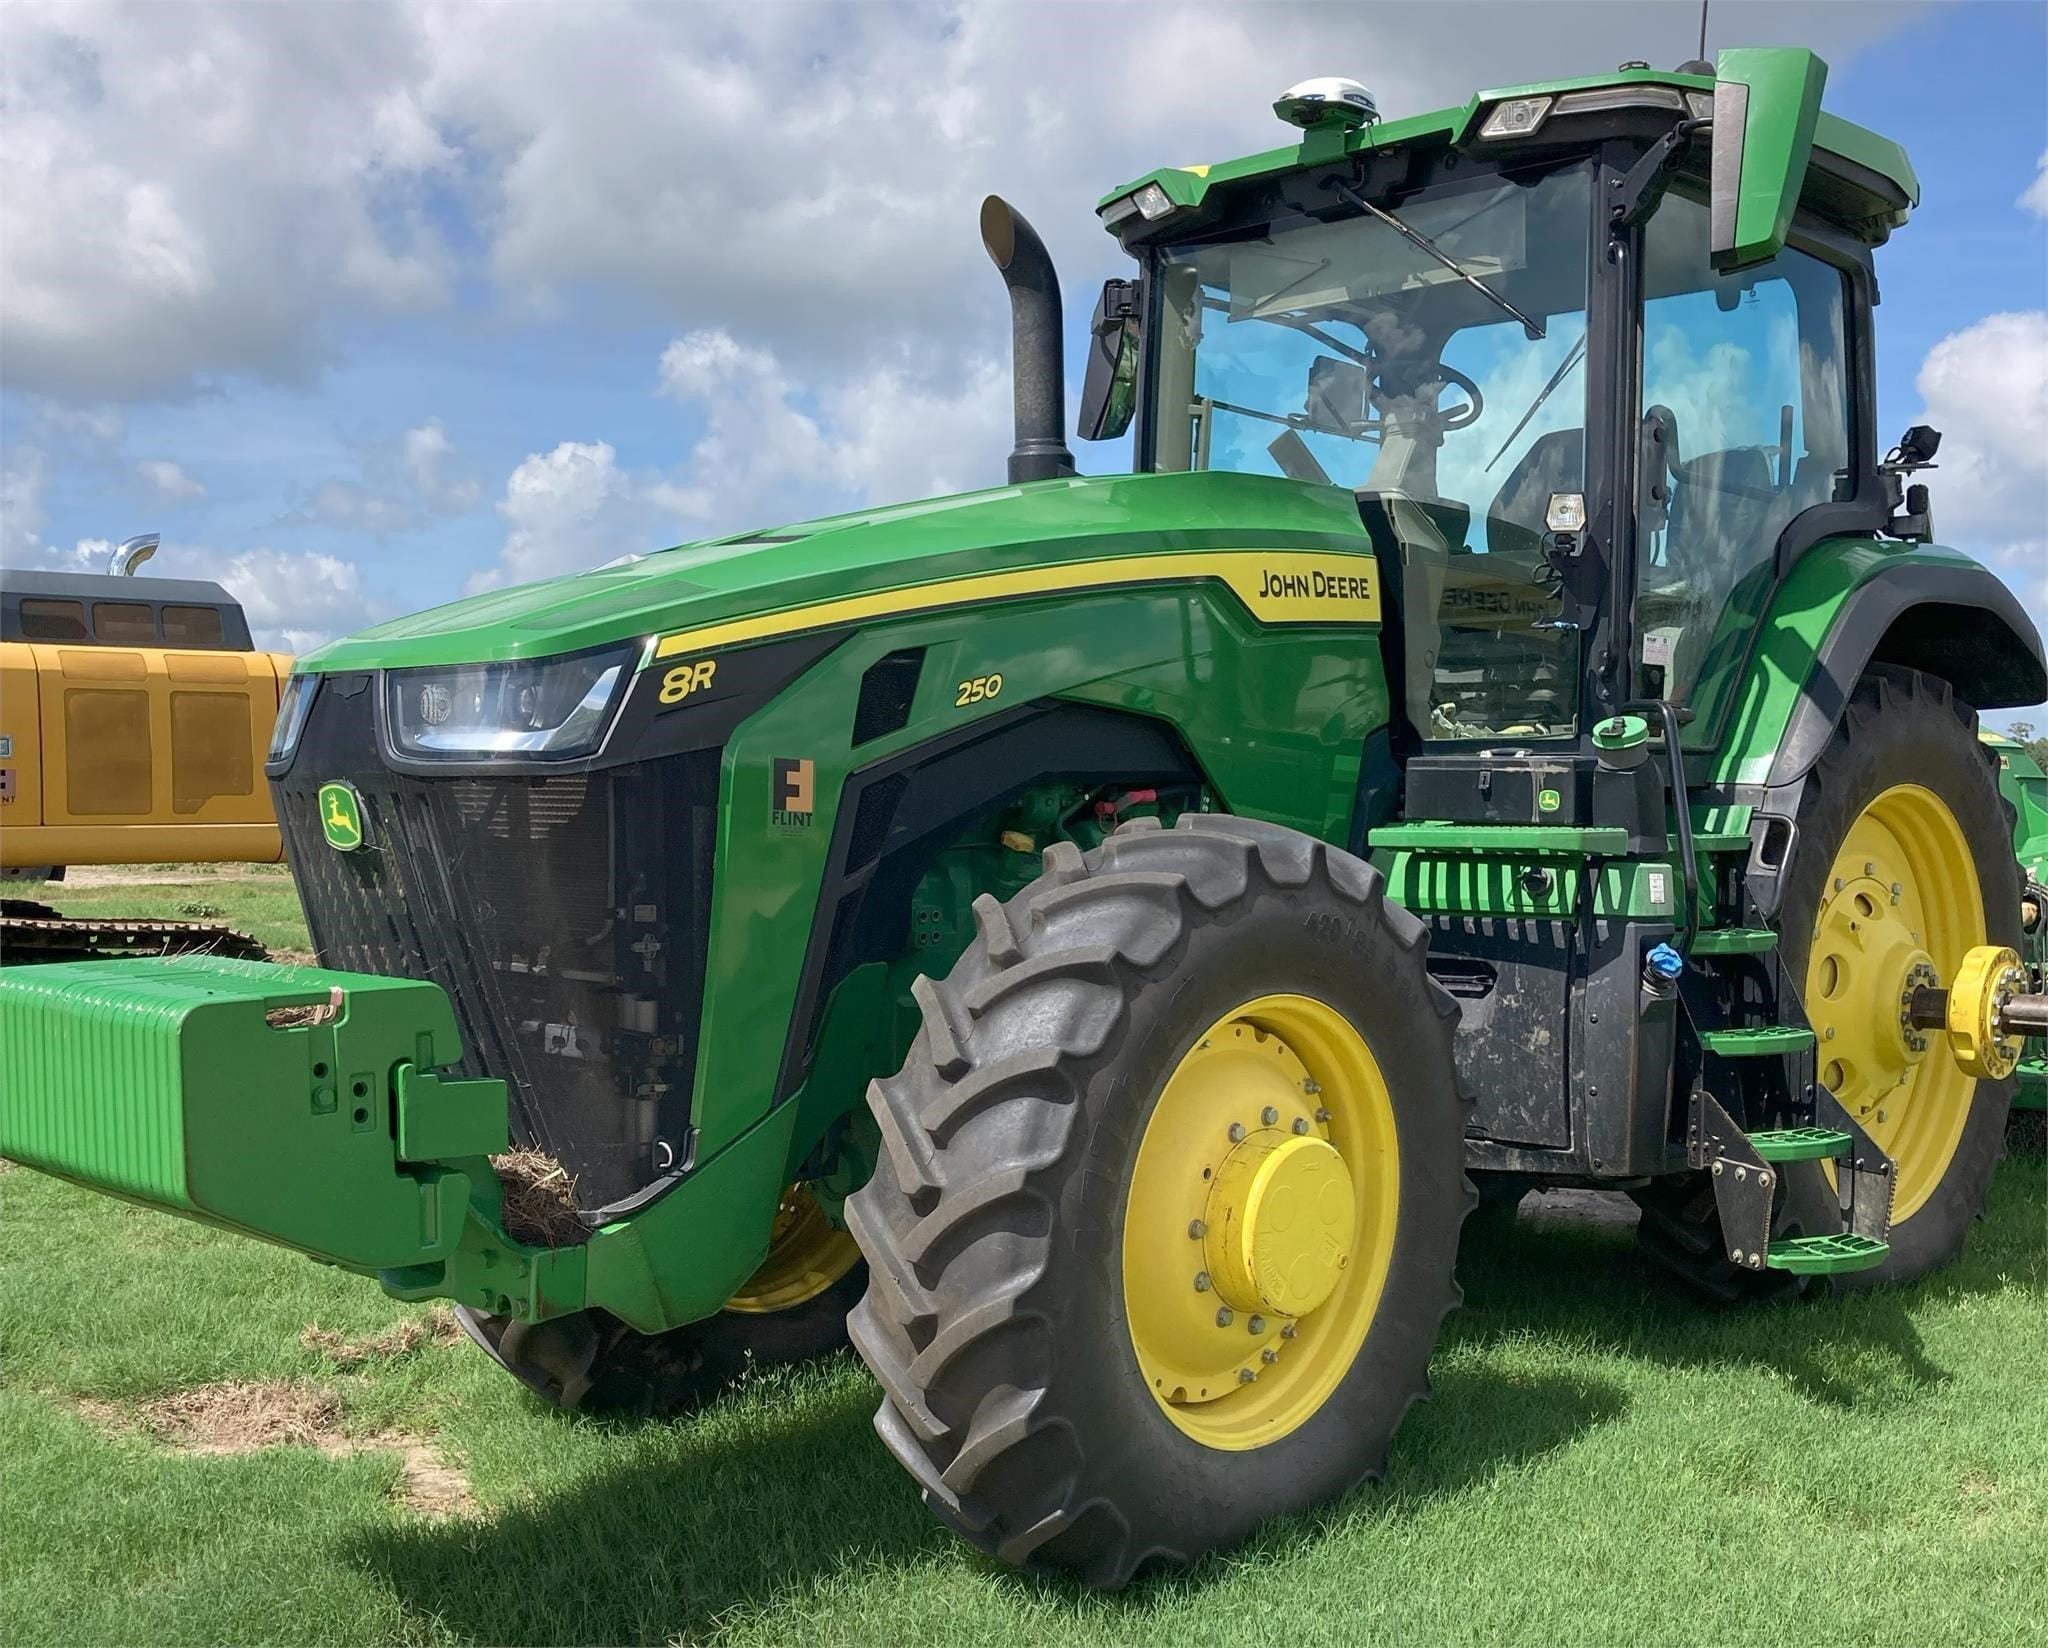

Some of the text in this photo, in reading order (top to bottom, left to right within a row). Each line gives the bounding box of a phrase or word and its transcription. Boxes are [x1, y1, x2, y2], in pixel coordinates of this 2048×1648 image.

[1259, 569, 1370, 599] JOHN DEERE
[658, 660, 717, 704] 8R
[955, 672, 1003, 708] 250
[772, 811, 813, 827] FLINT
